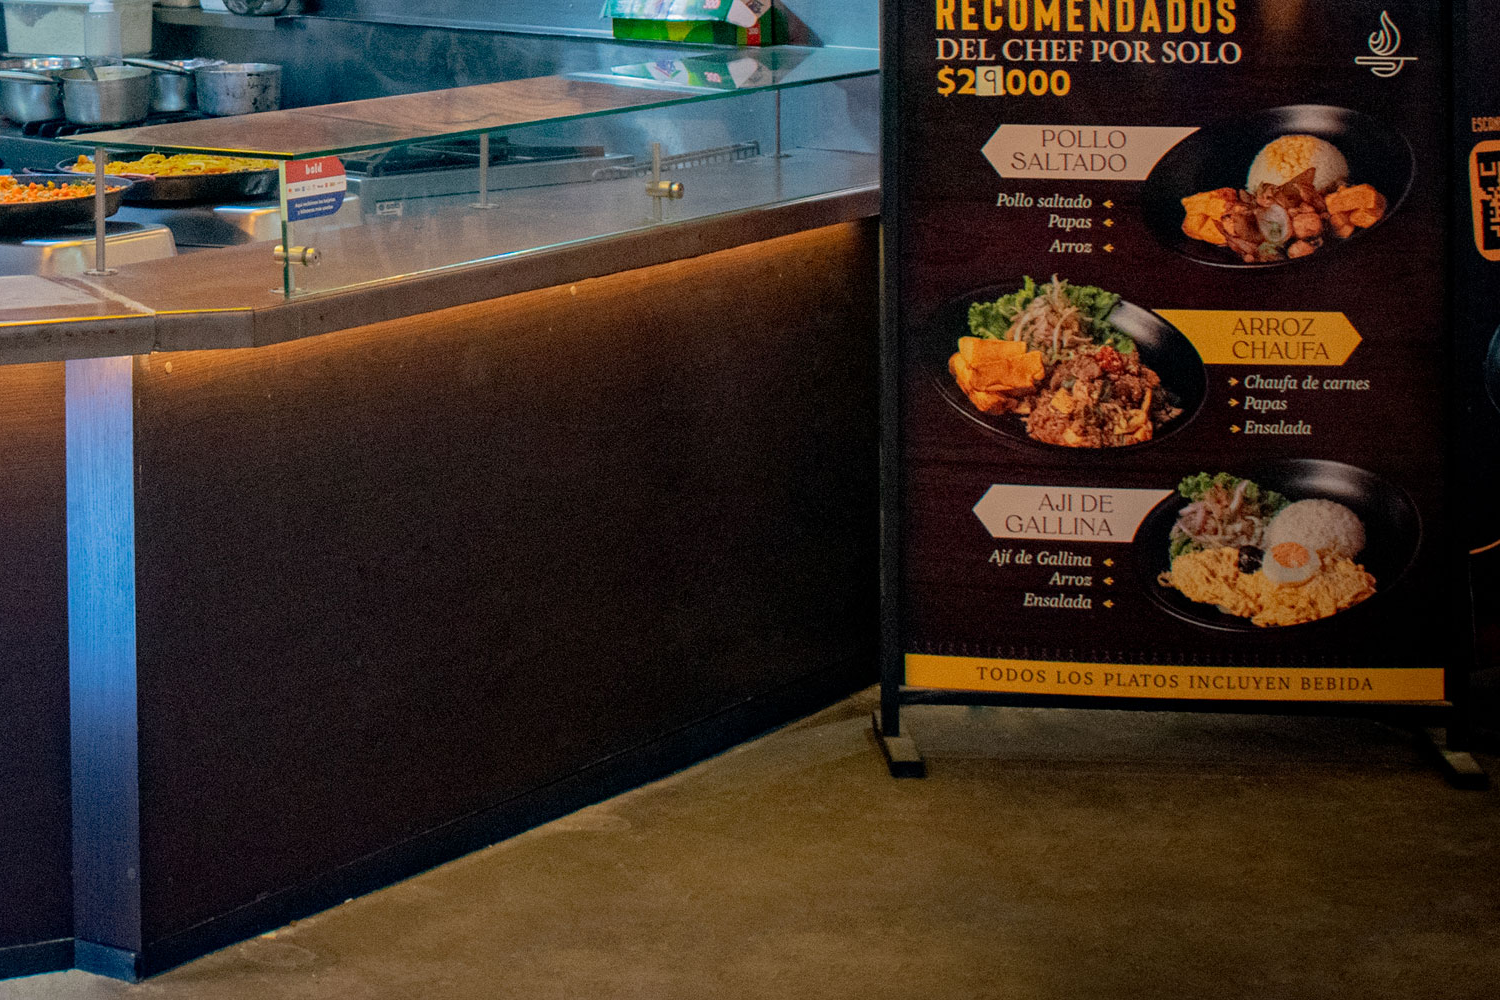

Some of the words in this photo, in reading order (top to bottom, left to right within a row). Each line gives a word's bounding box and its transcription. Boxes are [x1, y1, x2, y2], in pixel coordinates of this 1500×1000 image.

[935, 38, 996, 61] DEL
[1002, 38, 1084, 62] CHEF
[1090, 40, 1156, 63] POR
[1161, 40, 1243, 64] SOLO
[1041, 129, 1127, 149] POLLO
[1011, 151, 1128, 173] SALTADO
[996, 192, 1033, 208] Pollo
[1036, 193, 1093, 209] saltado
[1048, 214, 1093, 232] Papas
[1049, 239, 1093, 253] Arroz
[1231, 317, 1316, 337] ARROZ
[1231, 340, 1330, 360] CHAUFA
[1243, 374, 1298, 393] Chaufa
[1301, 375, 1320, 390] de
[1322, 378, 1371, 391] carnes
[1243, 396, 1288, 414] Papas
[1243, 419, 1312, 435] Ensalada
[1038, 493, 1073, 512] AJI
[1081, 494, 1114, 513] DE
[1005, 514, 1114, 537] GALLINA
[988, 549, 1012, 567] Ají
[1015, 550, 1033, 565] de
[1036, 551, 1093, 567] Gallina
[1049, 571, 1093, 587] Arroz
[1023, 592, 1093, 610] Ensalada
[976, 666, 1047, 684] TODOS
[1056, 669, 1094, 686] LOS
[1103, 672, 1180, 689] PLATOS
[1188, 674, 1291, 691] INCLUYEN
[1300, 676, 1374, 692] BEBIDA
